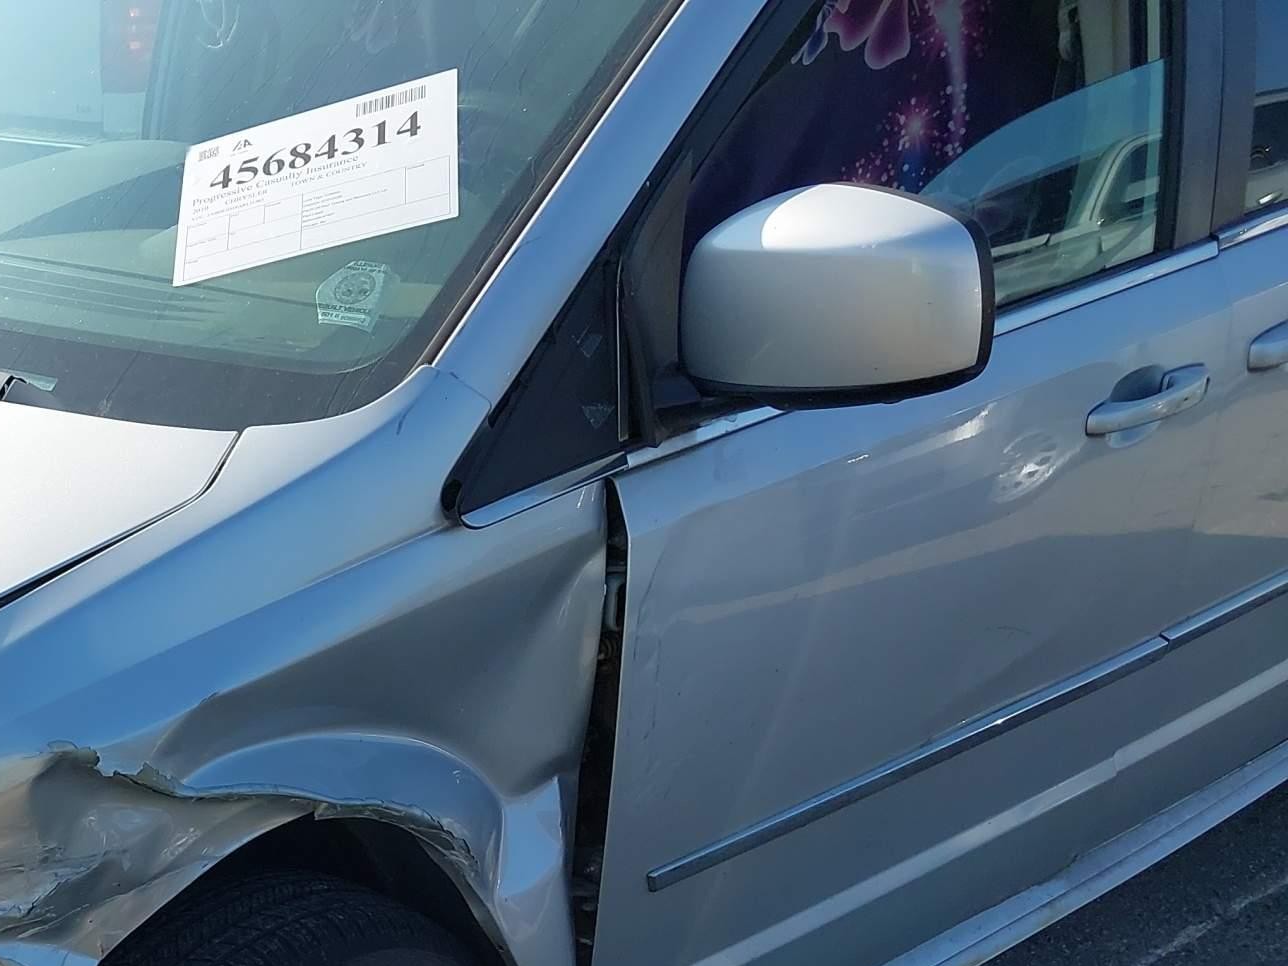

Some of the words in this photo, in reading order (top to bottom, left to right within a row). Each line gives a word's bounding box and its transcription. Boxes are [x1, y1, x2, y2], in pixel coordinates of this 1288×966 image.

[209, 110, 421, 189] 45684314
[325, 160, 367, 177] COUNTRY
[192, 184, 253, 207] Progressive
[256, 168, 303, 188] Casualty
[306, 156, 359, 175] Insurance
